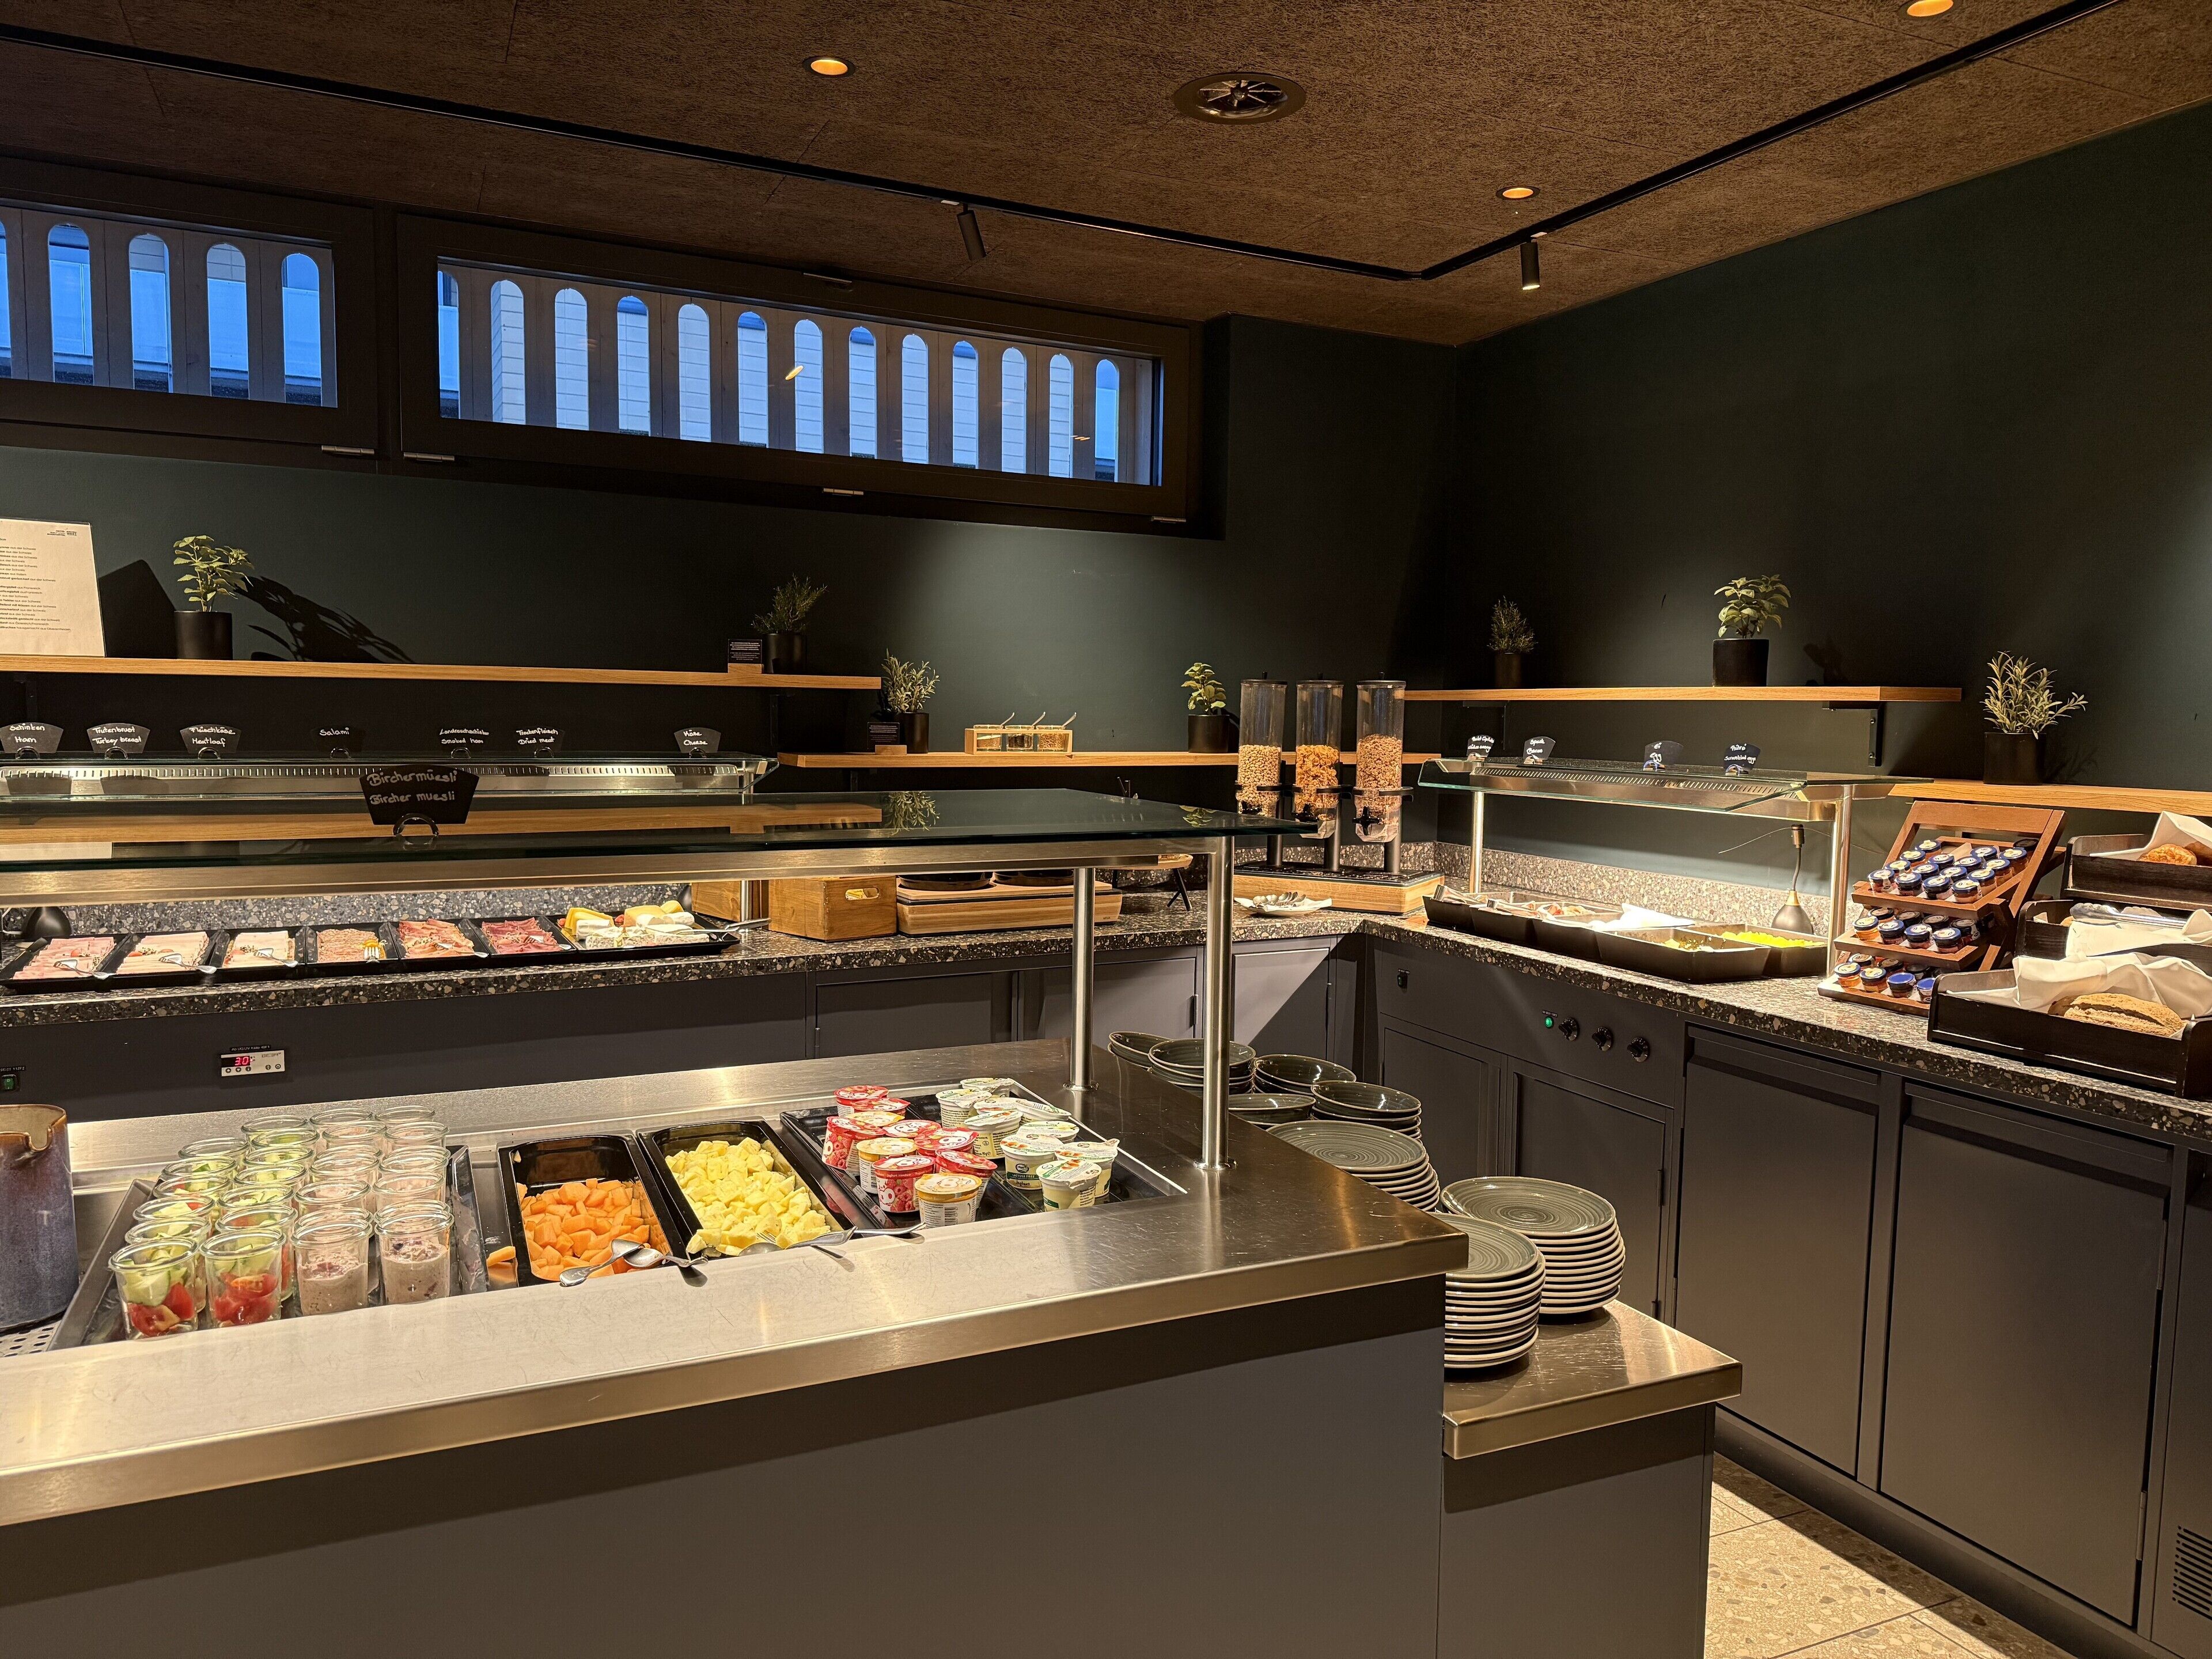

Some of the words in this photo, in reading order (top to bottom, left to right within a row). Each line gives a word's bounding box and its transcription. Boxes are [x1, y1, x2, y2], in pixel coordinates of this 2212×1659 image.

[9, 723, 46, 731] Schinken
[189, 726, 236, 735] Fleischkäse
[319, 727, 350, 736] Salami
[92, 737, 118, 746] Turkey
[192, 737, 226, 747] Meatloaf
[1747, 756, 1756, 764] eggs
[366, 769, 458, 786] Birchermüesli
[369, 792, 411, 805] Bircher
[416, 791, 455, 802] muesli
